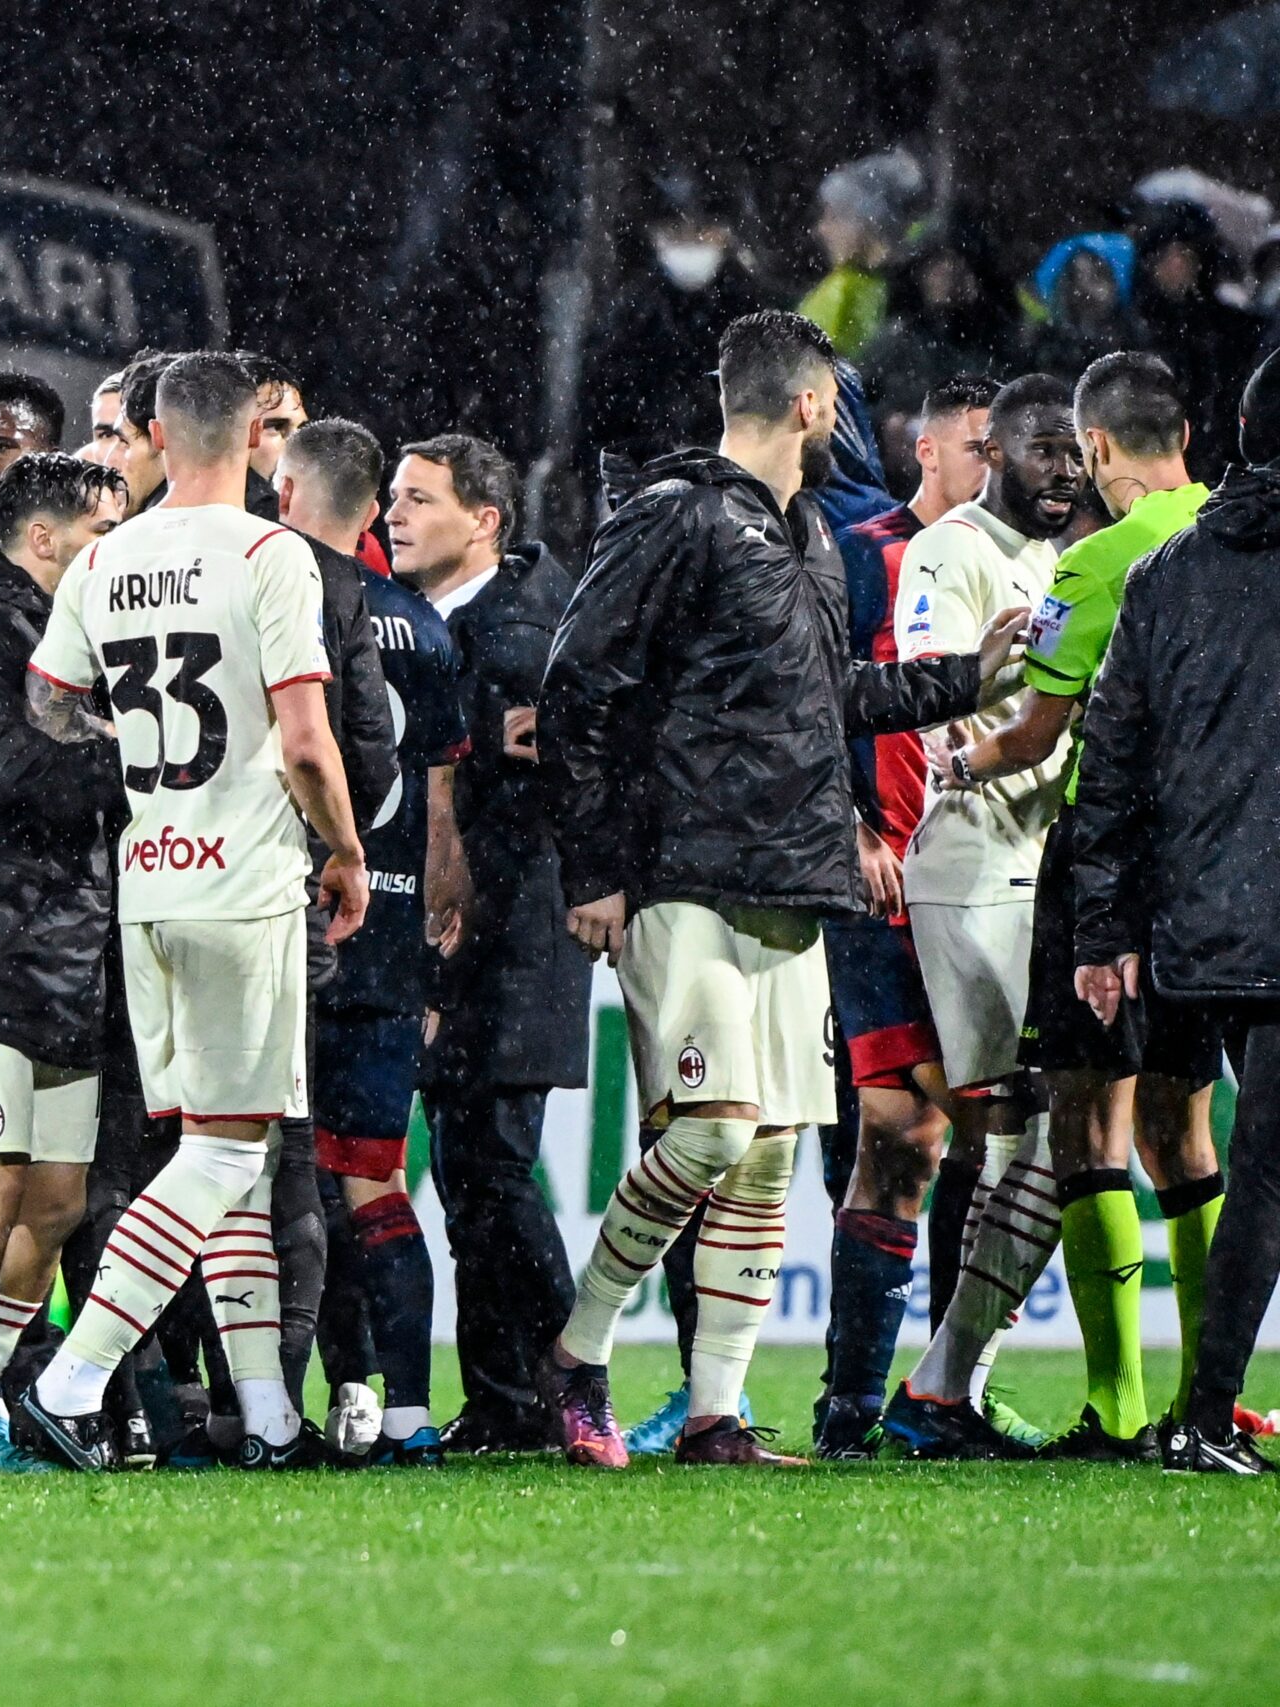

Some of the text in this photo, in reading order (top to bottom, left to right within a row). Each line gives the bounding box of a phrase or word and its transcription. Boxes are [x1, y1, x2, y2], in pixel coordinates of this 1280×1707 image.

[109, 558, 202, 612] KRUNIĆ
[369, 615, 416, 651] RIN
[102, 632, 228, 794] 33
[370, 870, 417, 895] nusa
[620, 1225, 668, 1248] ACM
